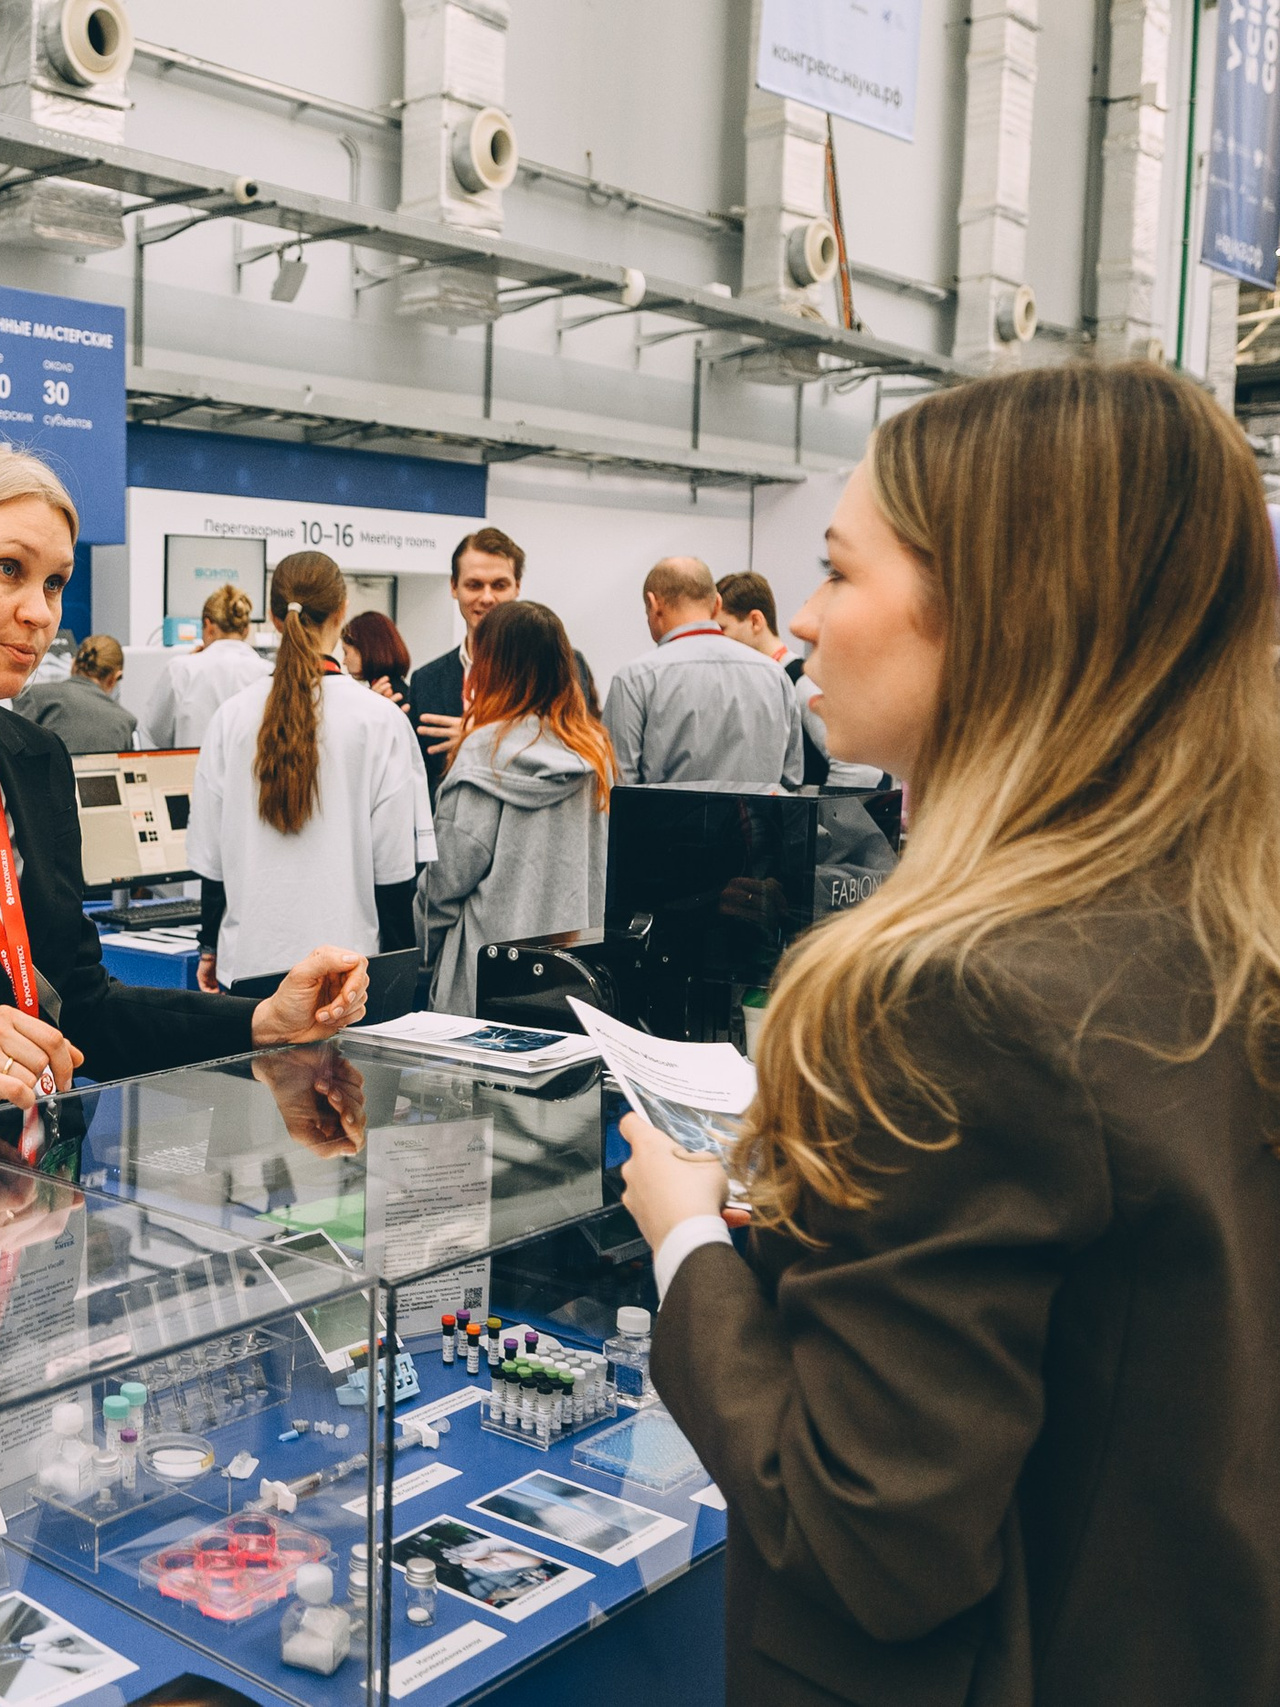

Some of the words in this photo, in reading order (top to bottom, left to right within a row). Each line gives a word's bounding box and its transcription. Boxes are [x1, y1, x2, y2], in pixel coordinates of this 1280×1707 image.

[33, 323, 114, 349] МАСТЕРСКИЕ
[42, 359, 74, 373] около
[42, 379, 70, 407] 30
[204, 518, 296, 539] Переговорные
[360, 530, 403, 548] Meeting
[404, 537, 437, 549] rooms
